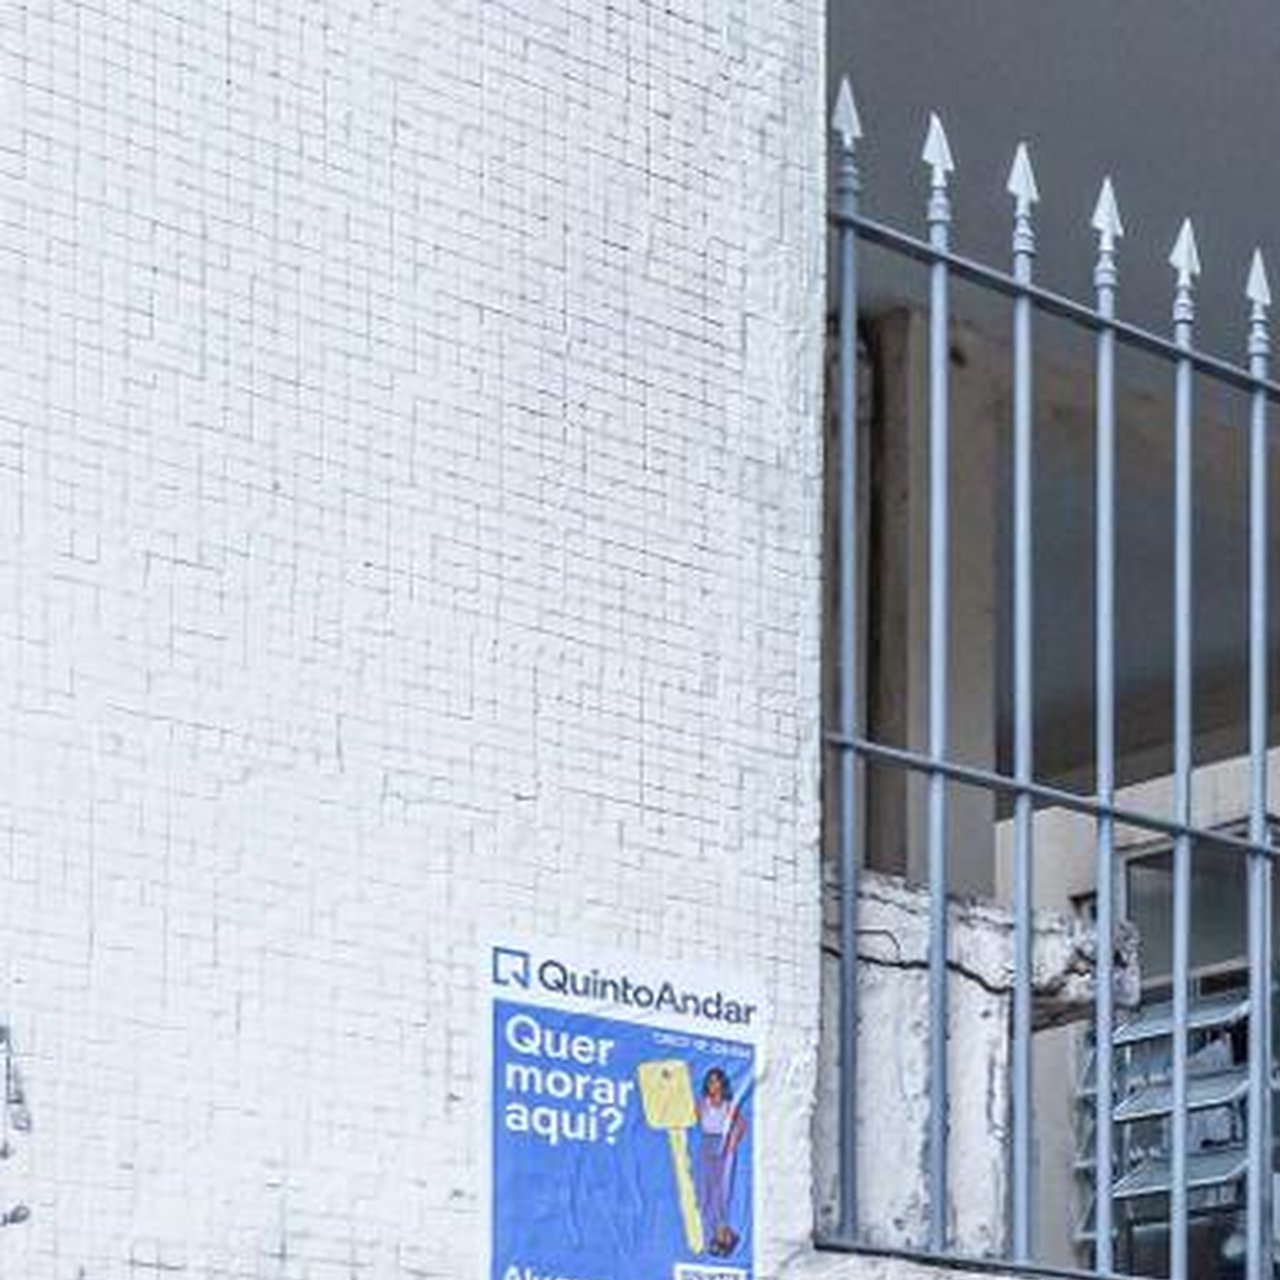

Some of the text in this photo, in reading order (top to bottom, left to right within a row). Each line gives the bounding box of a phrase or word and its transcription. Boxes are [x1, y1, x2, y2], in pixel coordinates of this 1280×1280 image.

[538, 959, 757, 1025] QuintoAndar
[505, 1014, 614, 1066] Quer
[505, 1061, 634, 1108] morar
[505, 1103, 624, 1145] aqui?
